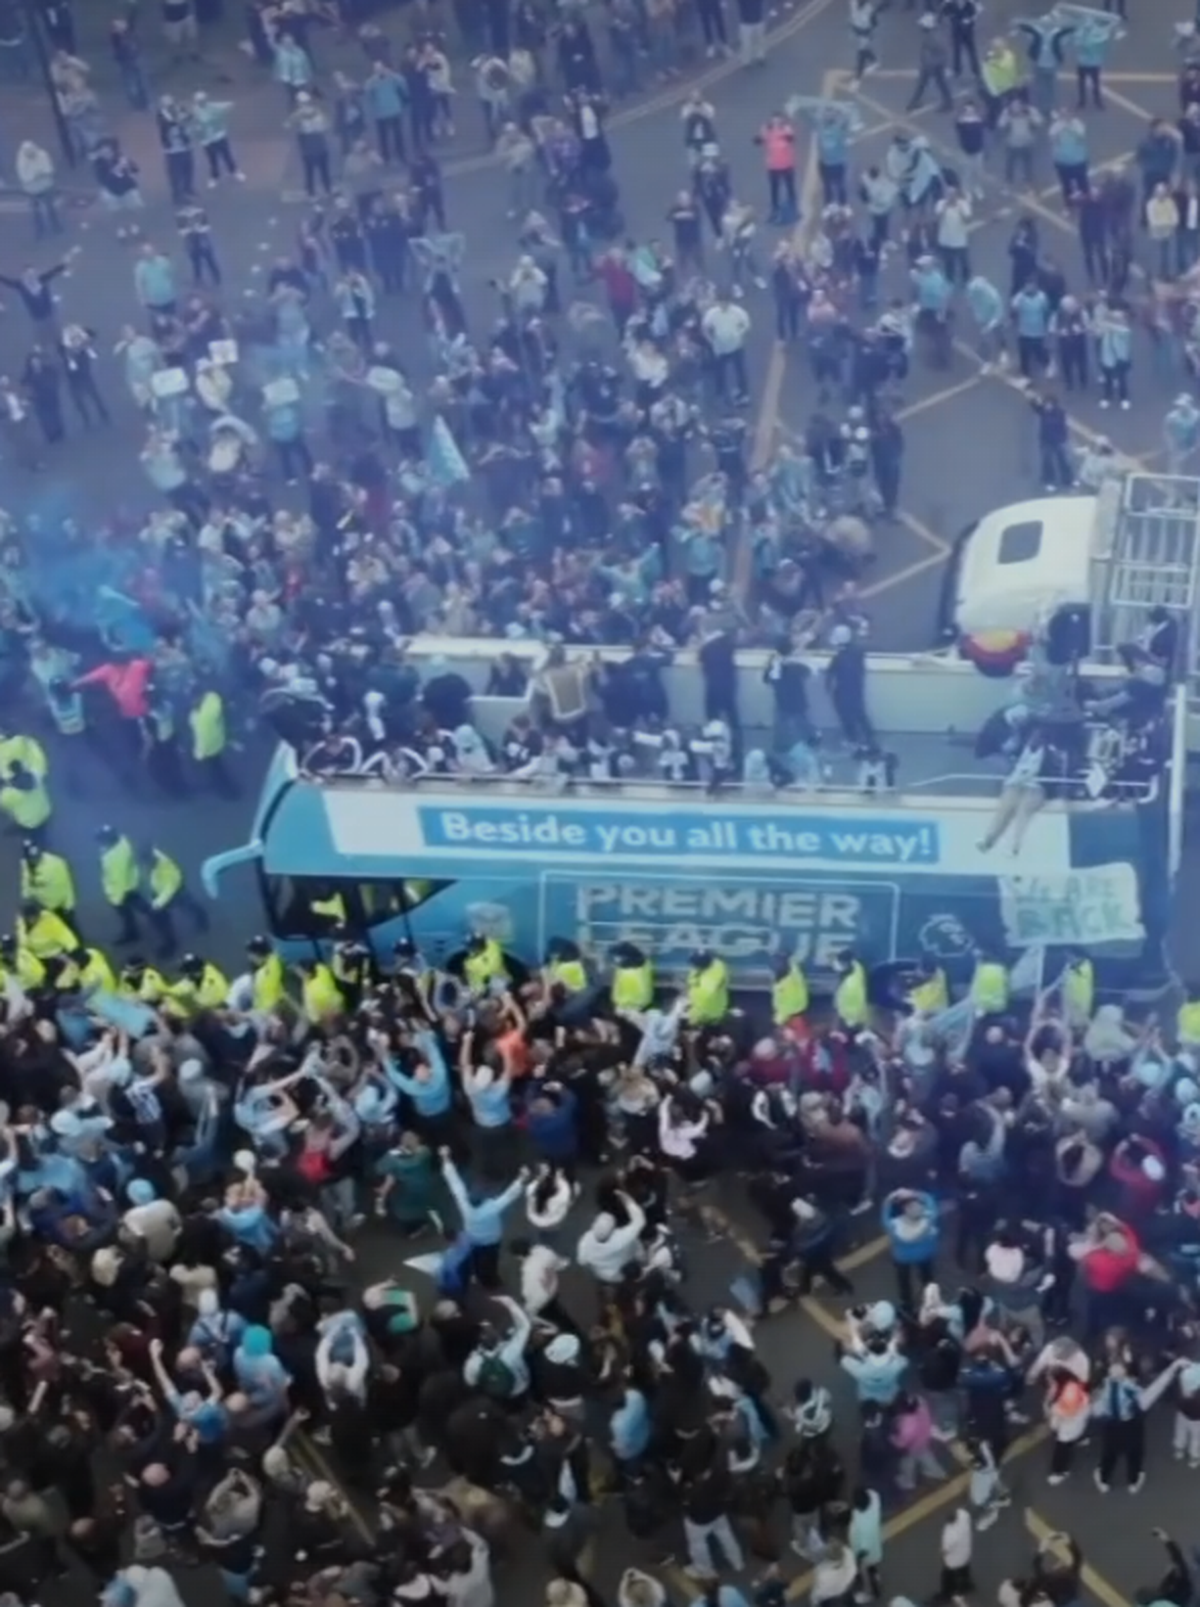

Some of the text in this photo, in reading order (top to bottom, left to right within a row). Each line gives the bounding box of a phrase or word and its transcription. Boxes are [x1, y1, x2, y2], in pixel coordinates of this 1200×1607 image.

[441, 811, 931, 861] Beside you all the way!
[577, 884, 860, 928] PREMIER
